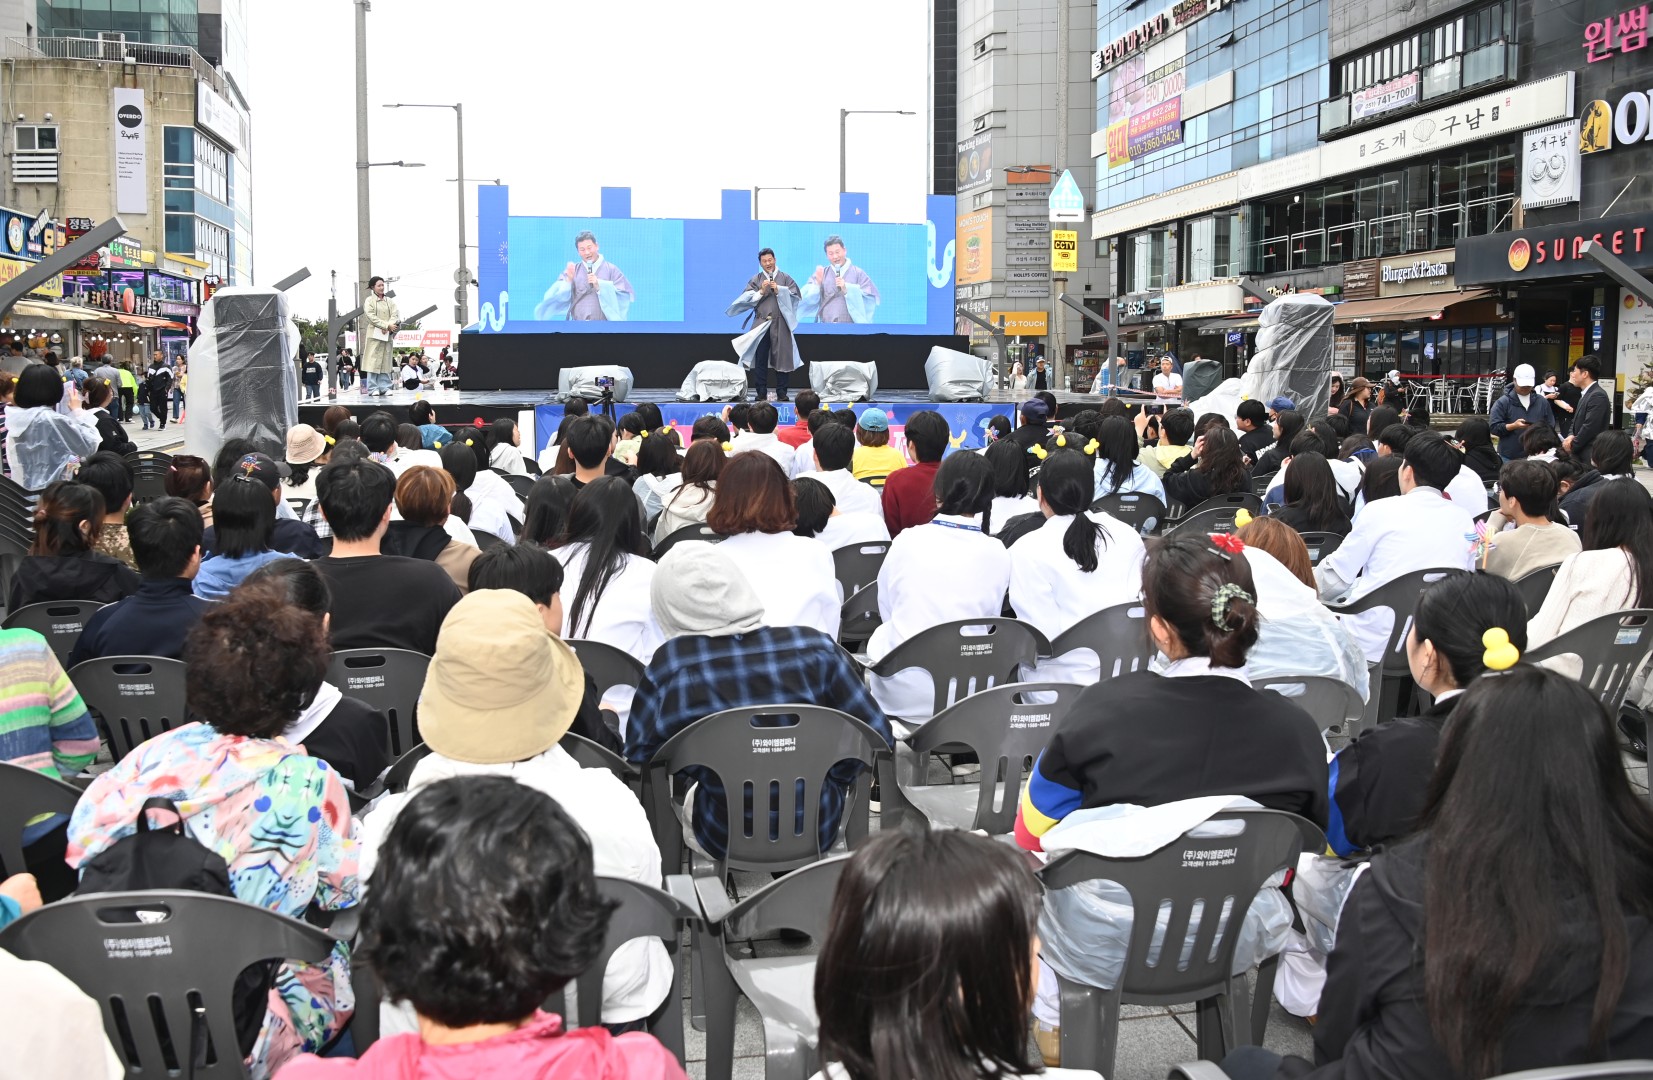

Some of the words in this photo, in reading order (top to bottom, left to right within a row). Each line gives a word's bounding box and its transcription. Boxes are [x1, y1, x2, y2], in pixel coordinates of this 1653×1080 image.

[1377, 85, 1414, 107] 741-7001
[1614, 90, 1653, 145] O
[1370, 129, 1406, 155] 조개
[1440, 108, 1485, 137] 구남
[1108, 124, 1128, 163] 임대
[1054, 241, 1074, 249] CCTV
[1128, 301, 1145, 316] GS25
[1228, 333, 1242, 341] Cass
